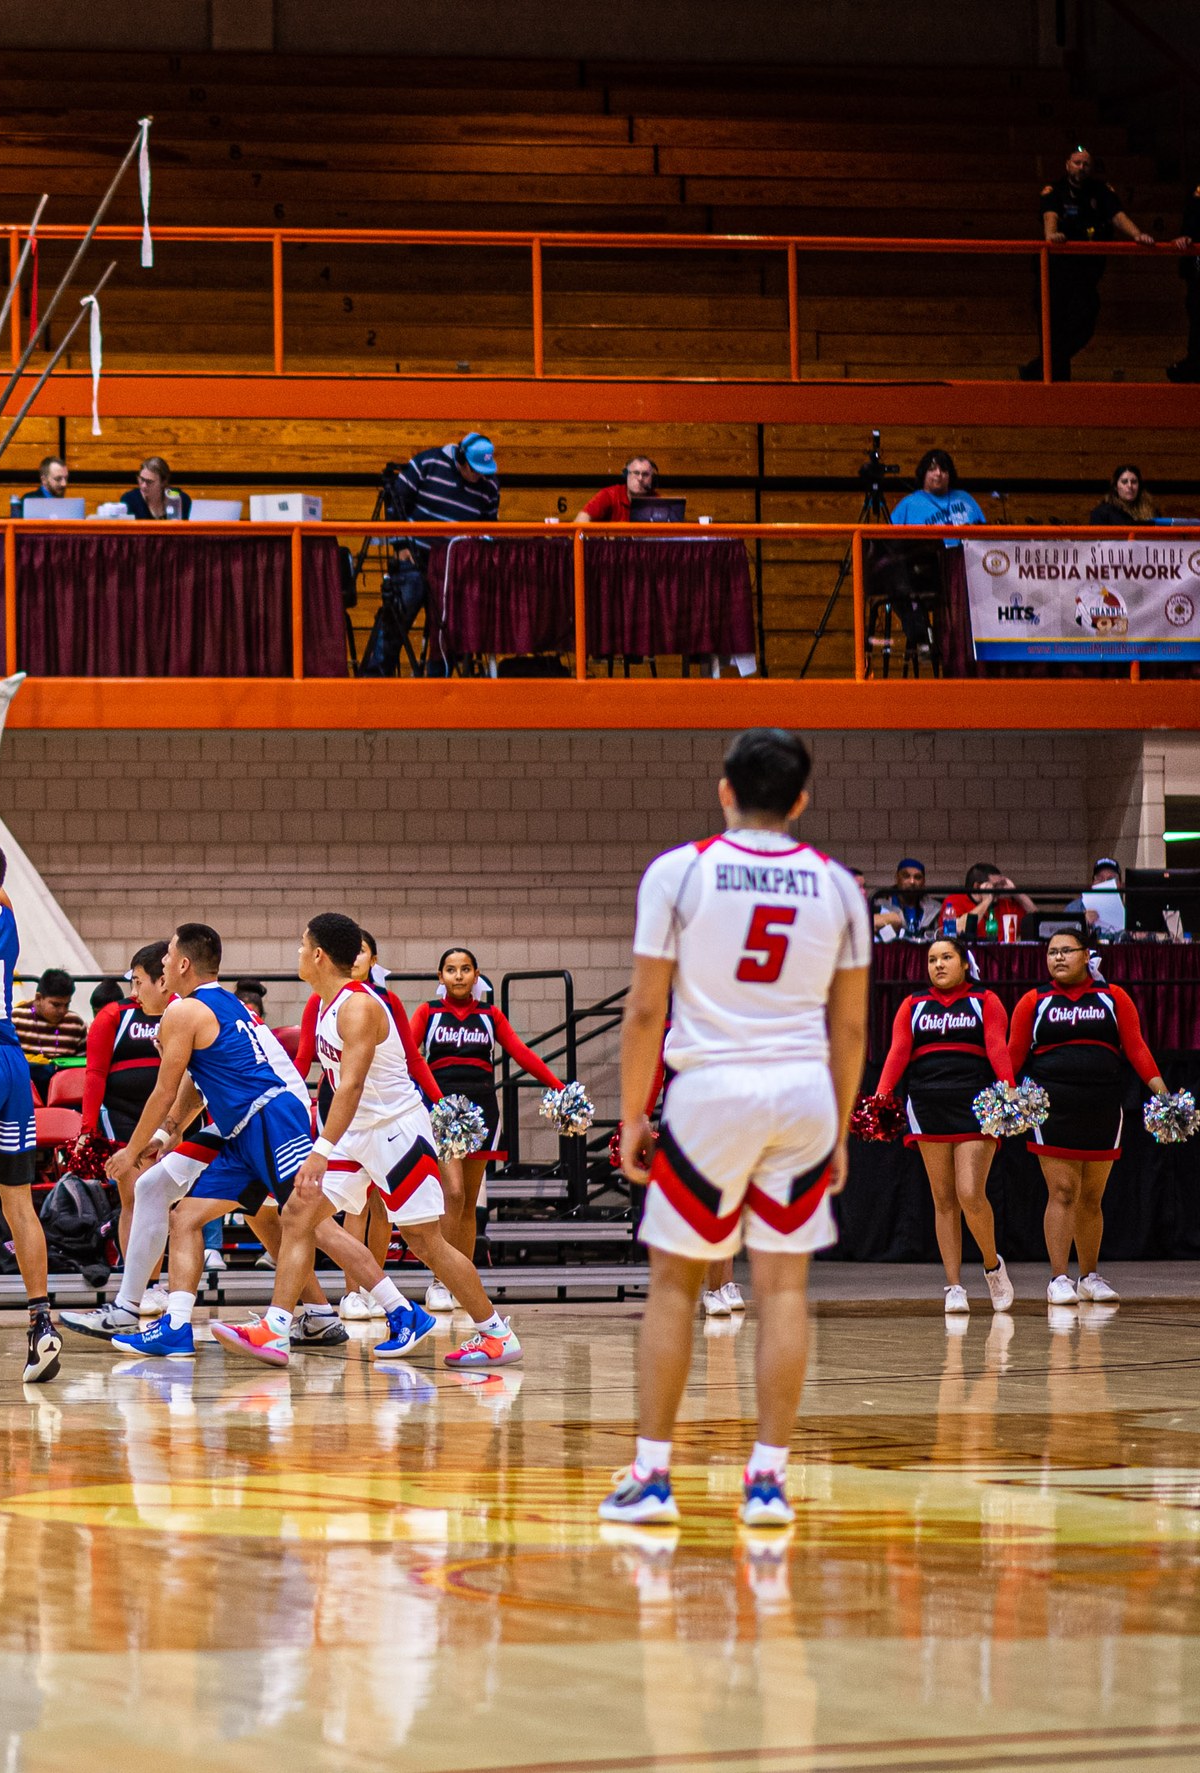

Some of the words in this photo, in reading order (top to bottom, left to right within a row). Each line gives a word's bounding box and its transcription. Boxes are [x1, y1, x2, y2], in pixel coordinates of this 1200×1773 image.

[274, 203, 285, 218] 6
[366, 330, 377, 346] 2
[557, 496, 567, 513] 6
[1018, 564, 1081, 580] MEDIA
[1086, 564, 1182, 580] NETWORK
[998, 606, 1034, 620] HITS
[716, 864, 820, 898] HUNKPATI
[735, 904, 798, 984] 5
[918, 1012, 977, 1035] Chieftains
[1049, 1006, 1106, 1025] Chieftains
[434, 1026, 490, 1047] Chieftains
